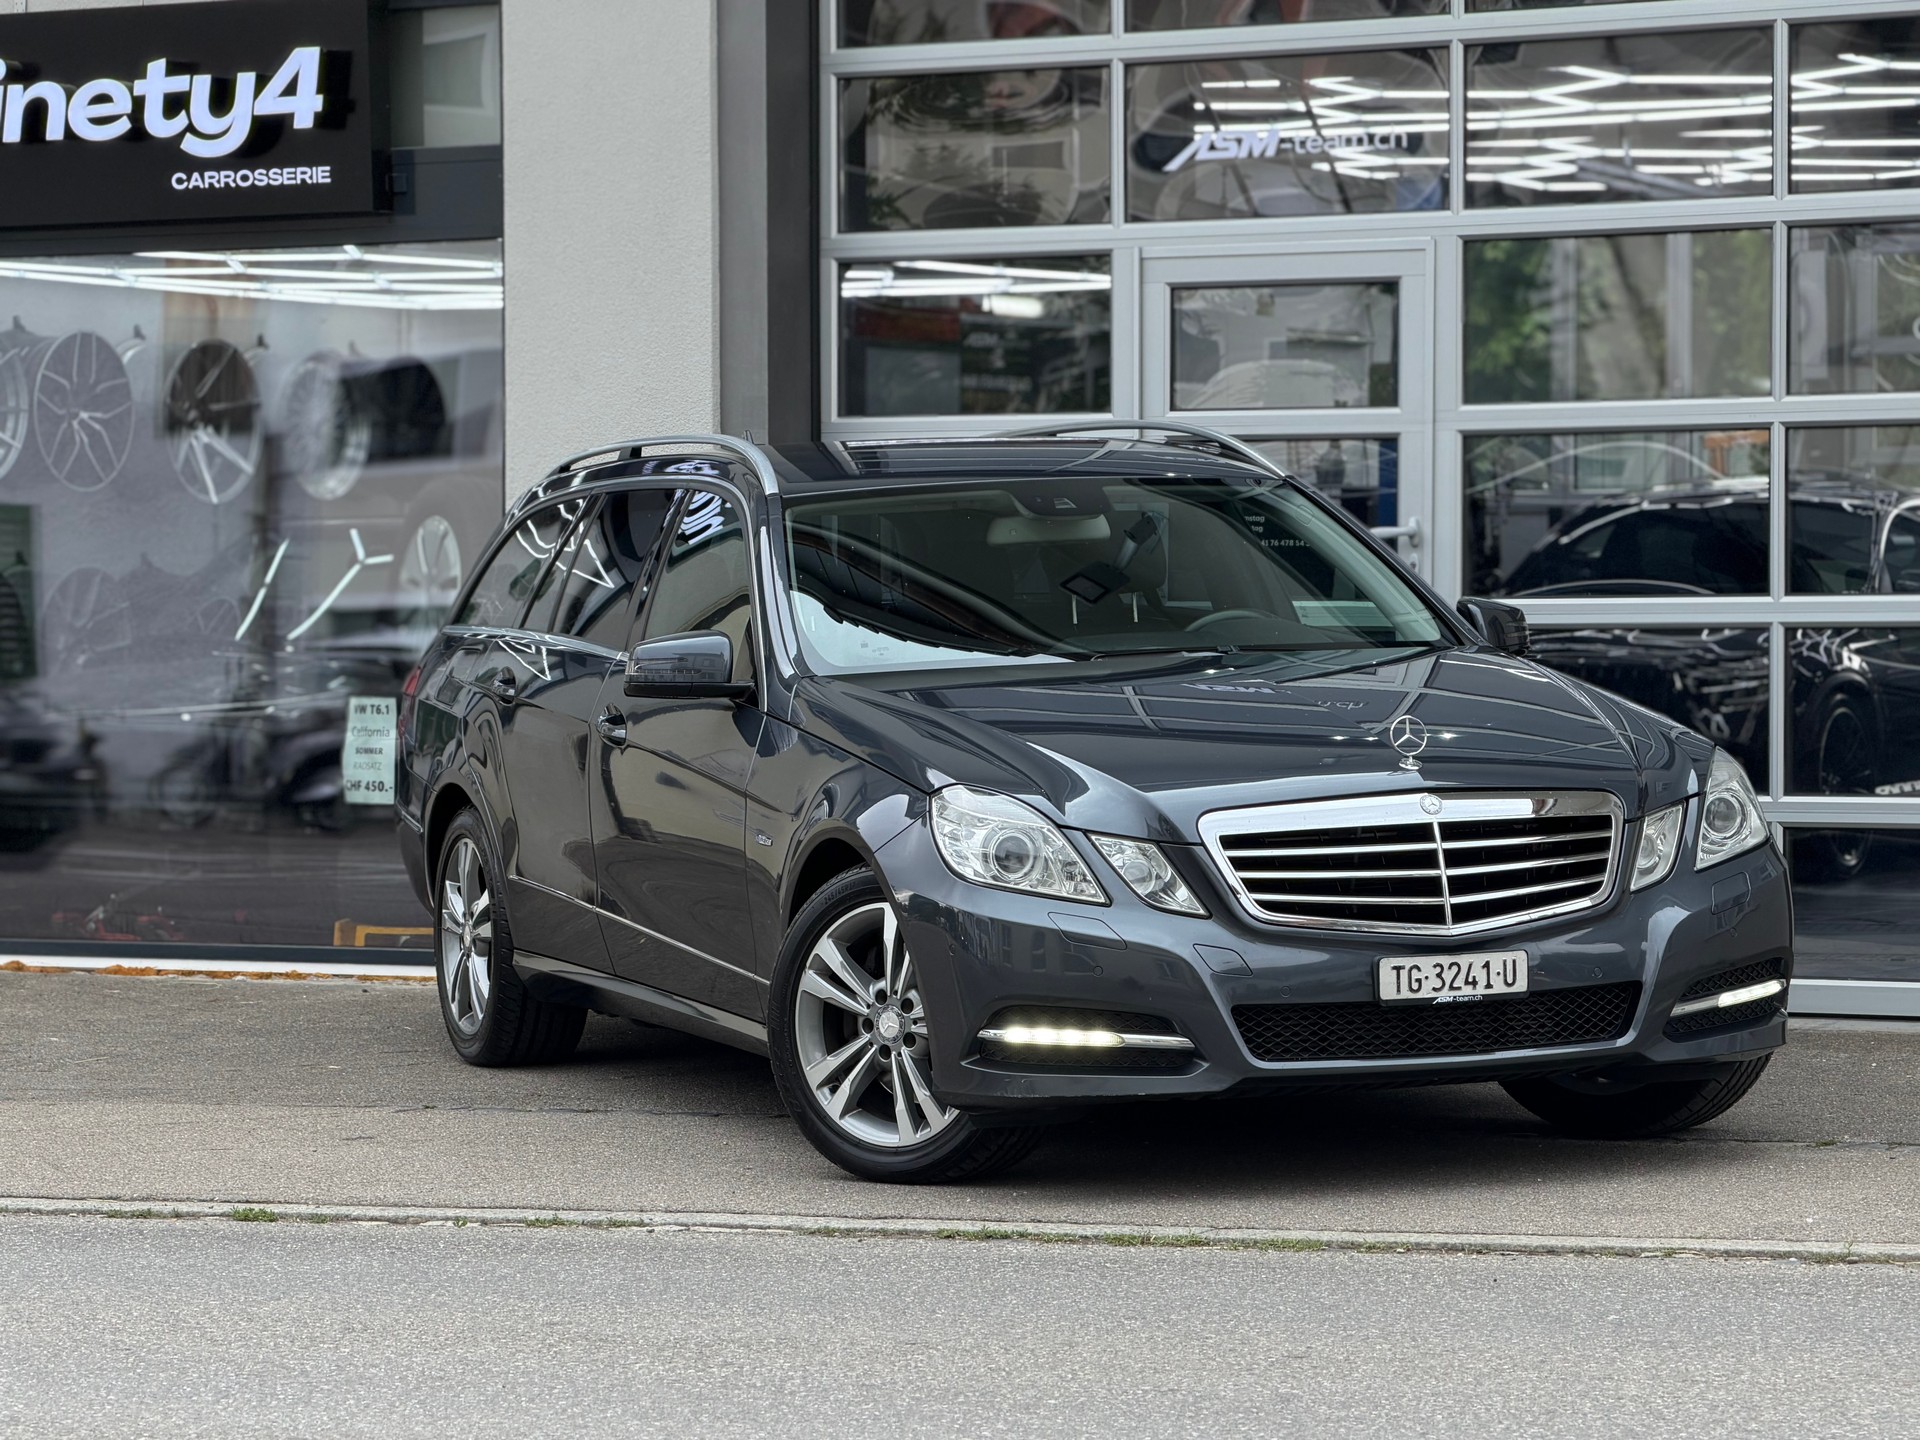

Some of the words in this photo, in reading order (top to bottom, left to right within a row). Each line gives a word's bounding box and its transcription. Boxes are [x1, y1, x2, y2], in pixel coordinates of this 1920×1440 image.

[171, 165, 332, 190] CARROSSERIE
[369, 704, 390, 715] T6.1
[345, 781, 362, 792] CHF
[364, 780, 394, 793] 450.-
